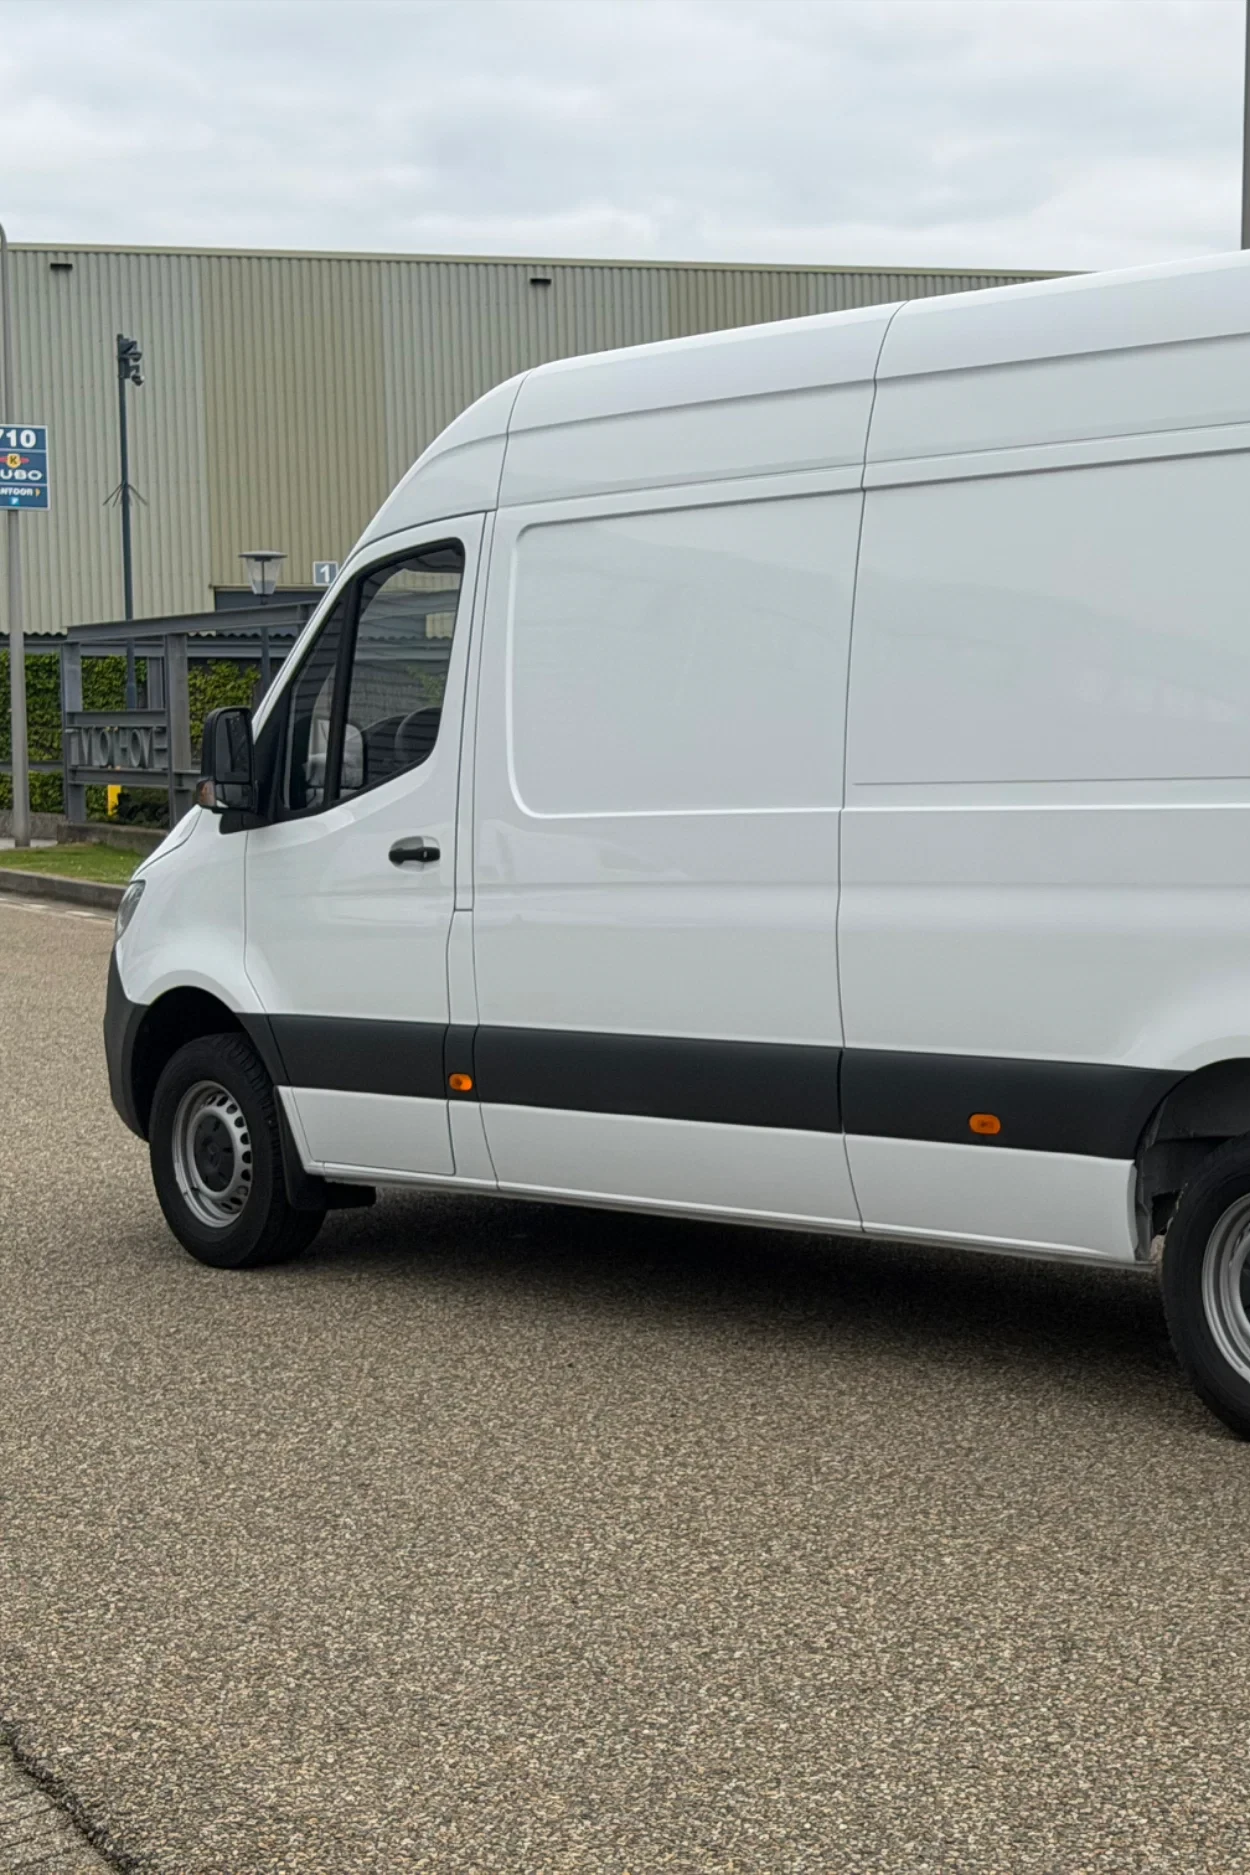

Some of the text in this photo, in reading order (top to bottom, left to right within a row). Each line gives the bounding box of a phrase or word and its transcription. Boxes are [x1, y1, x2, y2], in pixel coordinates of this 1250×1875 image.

[0, 469, 43, 480] UBO
[0, 487, 33, 497] NTOOR
[320, 565, 330, 583] 1
